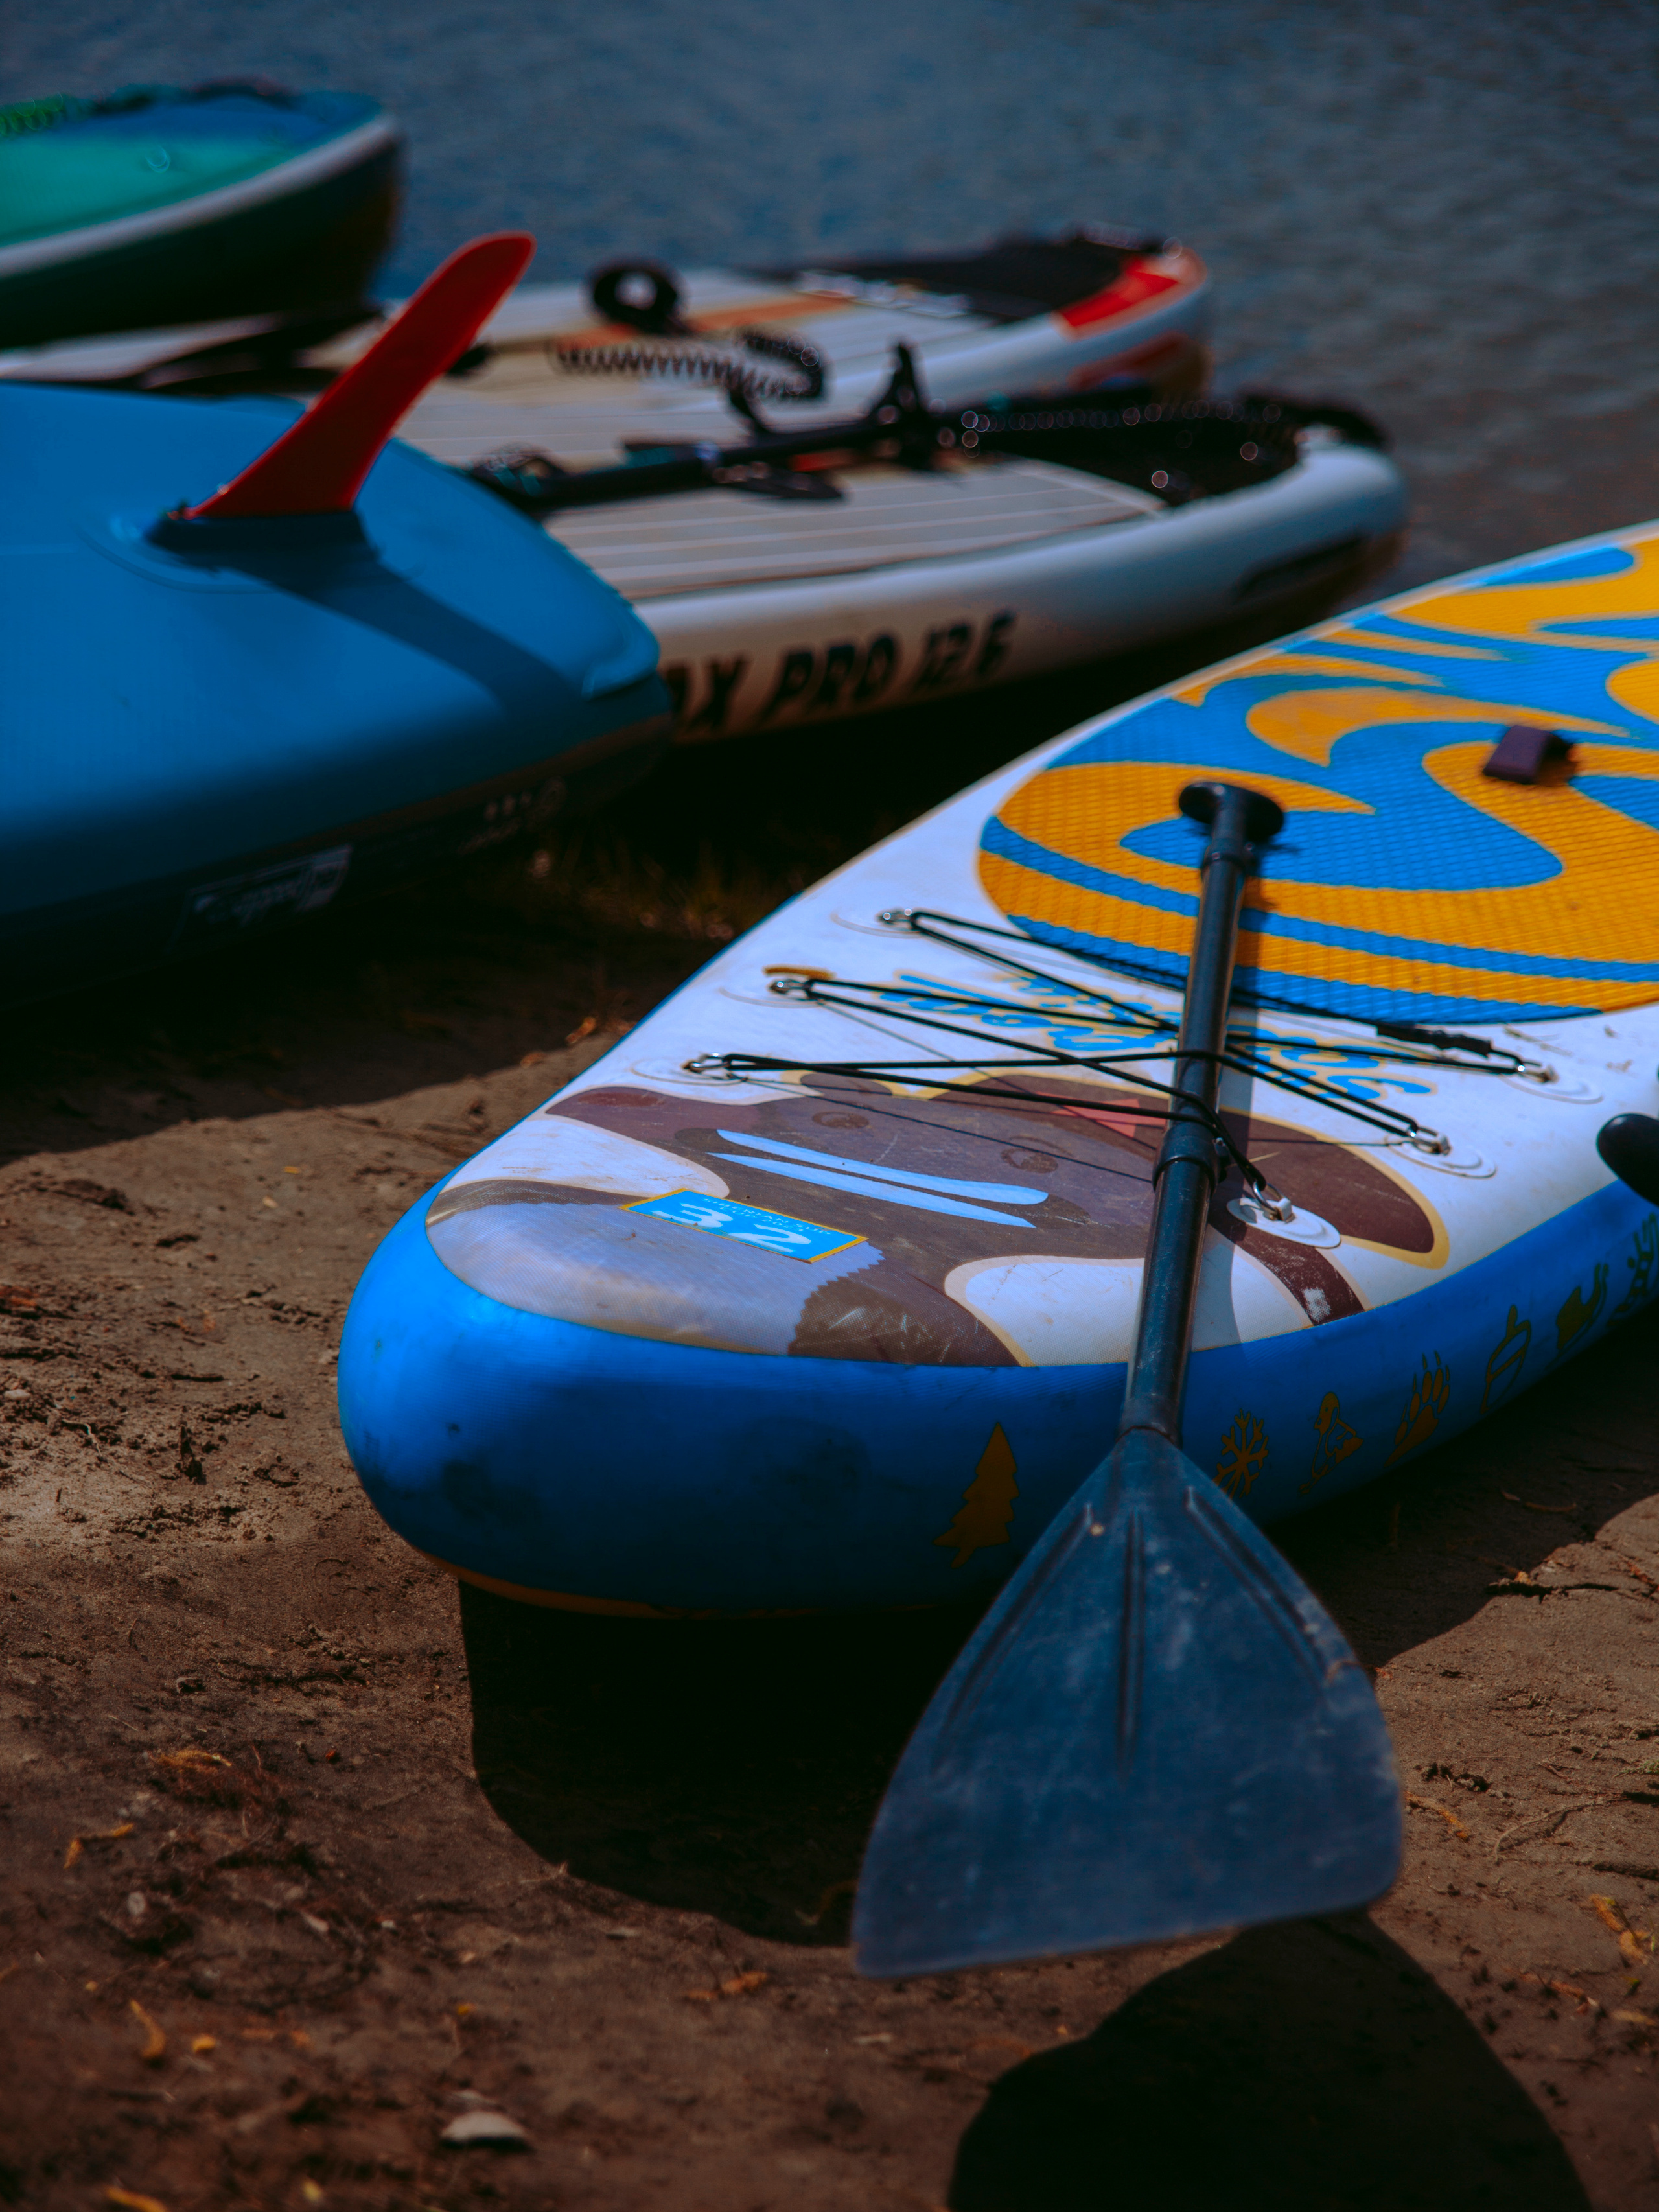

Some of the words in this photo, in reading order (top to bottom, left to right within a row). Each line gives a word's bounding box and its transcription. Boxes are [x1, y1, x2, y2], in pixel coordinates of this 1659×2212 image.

[769, 637, 897, 716] PRO
[651, 1203, 812, 1253] 32
[702, 1198, 789, 1224] SIBERIAN
[795, 1223, 831, 1235] SUP
[719, 1207, 758, 1218] CUP
